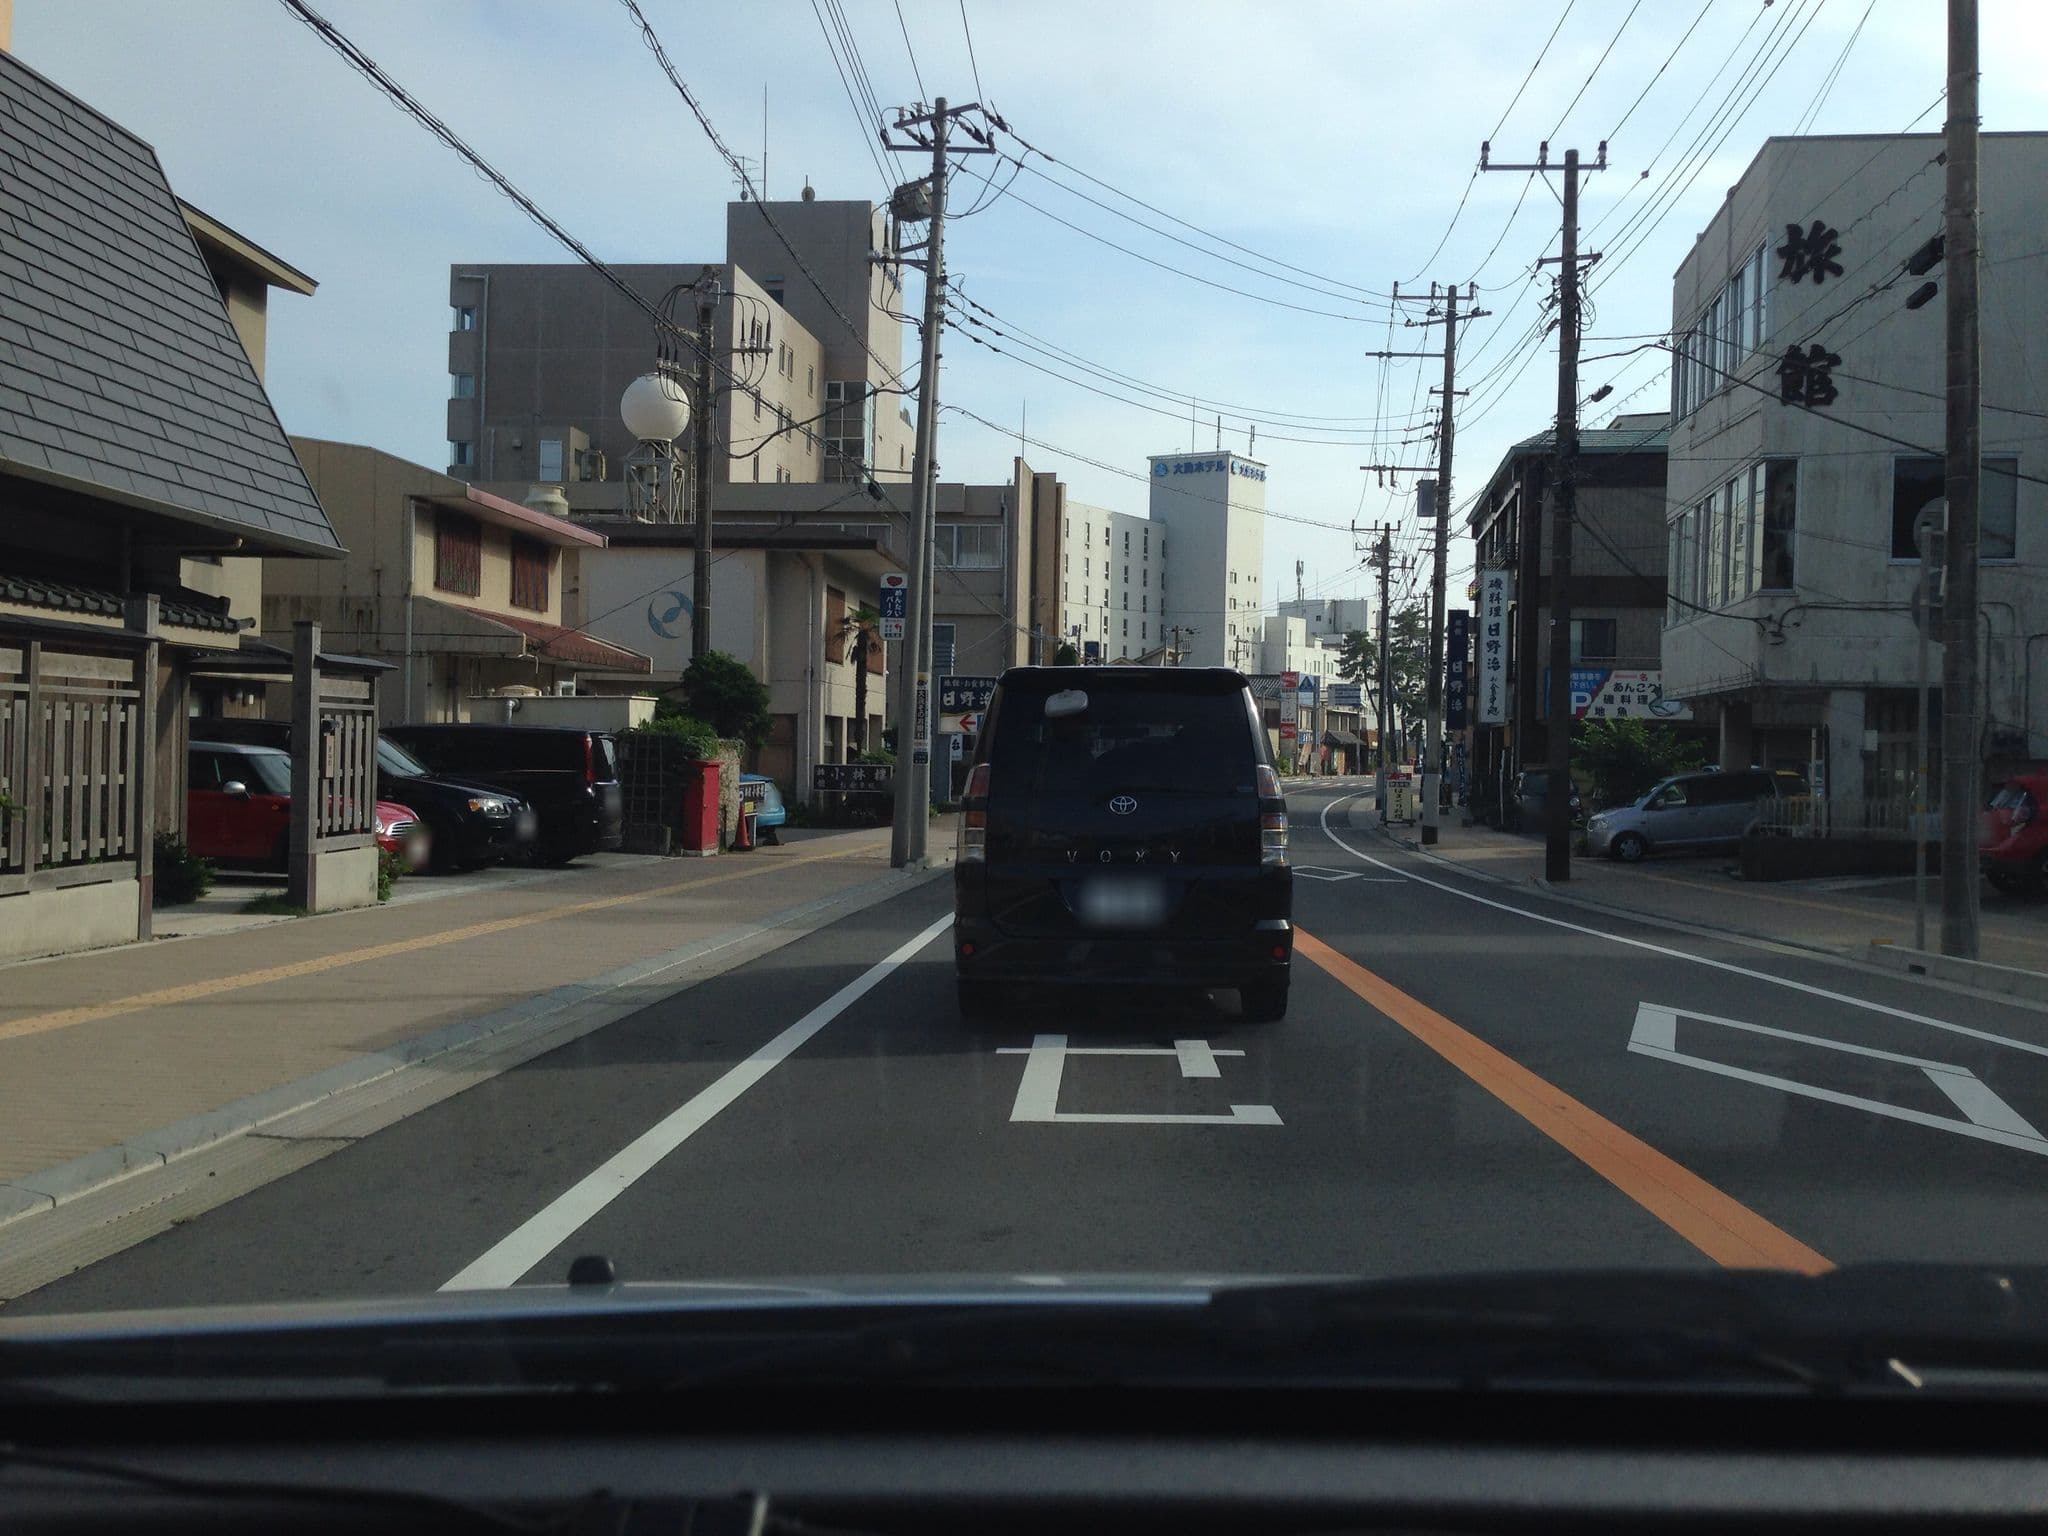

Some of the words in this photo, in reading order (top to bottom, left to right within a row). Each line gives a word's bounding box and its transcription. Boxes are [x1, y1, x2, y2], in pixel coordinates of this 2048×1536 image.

[1776, 219, 1844, 407] 旅館
[1571, 691, 1592, 715] P
[1067, 850, 1184, 863] VOXY
